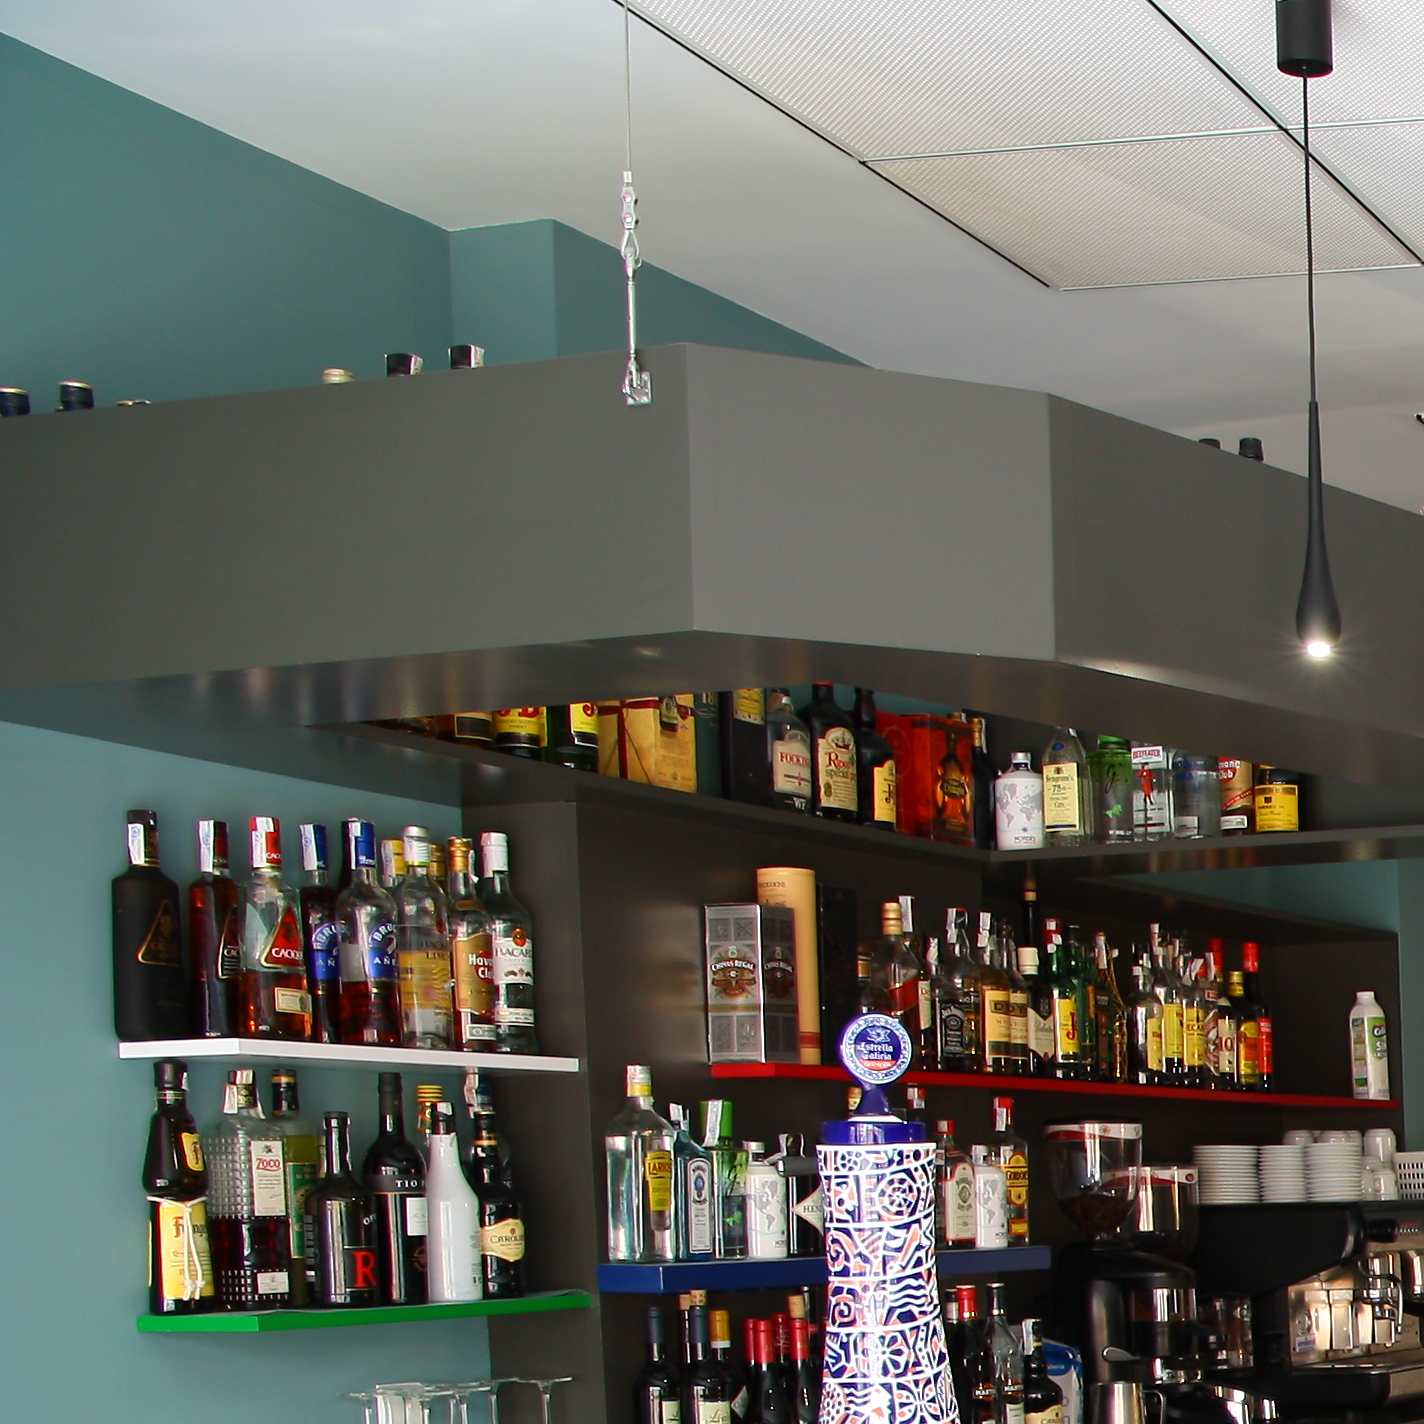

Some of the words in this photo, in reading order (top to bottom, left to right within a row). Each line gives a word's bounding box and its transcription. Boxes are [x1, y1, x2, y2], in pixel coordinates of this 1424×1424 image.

[860, 1042, 894, 1053] Estrella
[862, 1052, 892, 1061] Galicia
[256, 1157, 281, 1170] ZOCO
[395, 1179, 419, 1188] TIO
